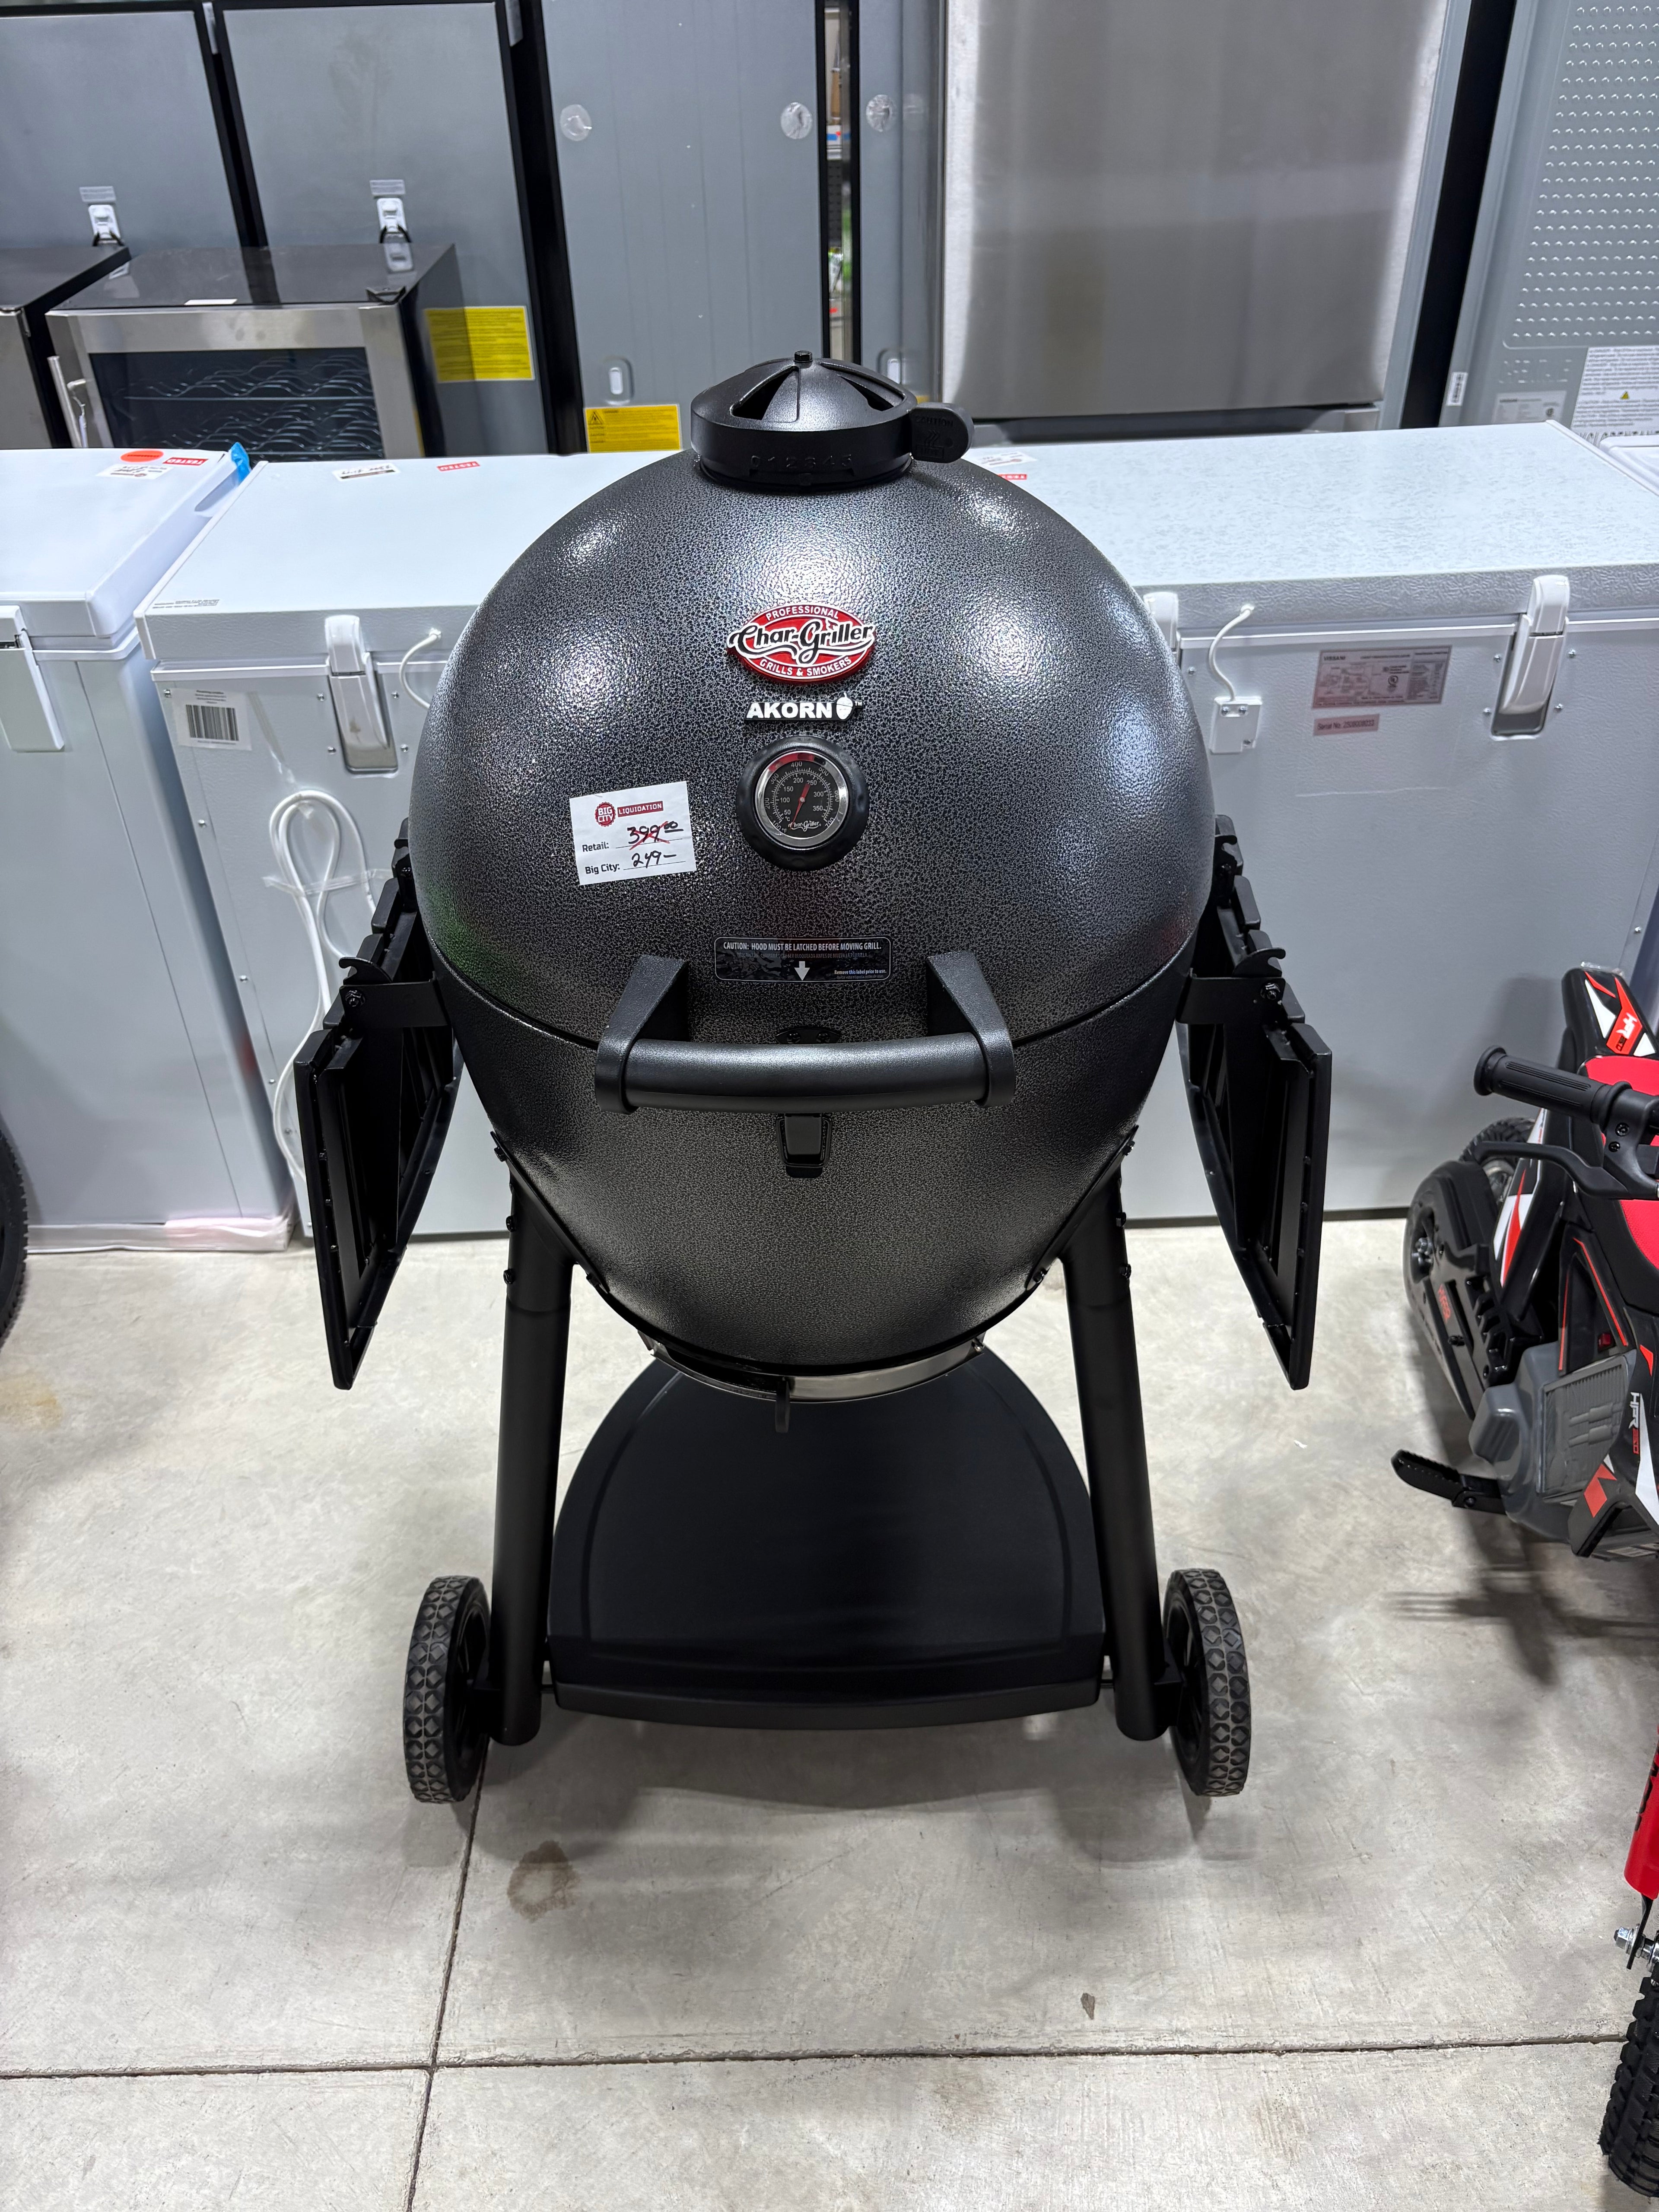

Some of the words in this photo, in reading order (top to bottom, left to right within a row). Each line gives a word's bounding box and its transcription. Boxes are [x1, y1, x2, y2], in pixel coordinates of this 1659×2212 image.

[766, 606, 839, 621] PROFESSIONAL
[728, 620, 873, 664] Char-Griller
[760, 659, 792, 676] GRILLS
[796, 667, 803, 676] &
[807, 656, 852, 676] SMOKERS
[746, 702, 832, 718] AKORN
[818, 767, 829, 776] 500
[770, 773, 779, 784] 300
[598, 806, 613, 816] BIG
[618, 803, 662, 815] LIQUIDATION
[597, 814, 613, 823] CITY
[825, 817, 835, 828] 700
[772, 820, 781, 831] 100
[582, 842, 609, 852] Retail:
[585, 866, 599, 874] Big
[601, 864, 620, 872] City:
[723, 942, 749, 950] CAUTION:
[1628, 1392, 1640, 1429] HPR
